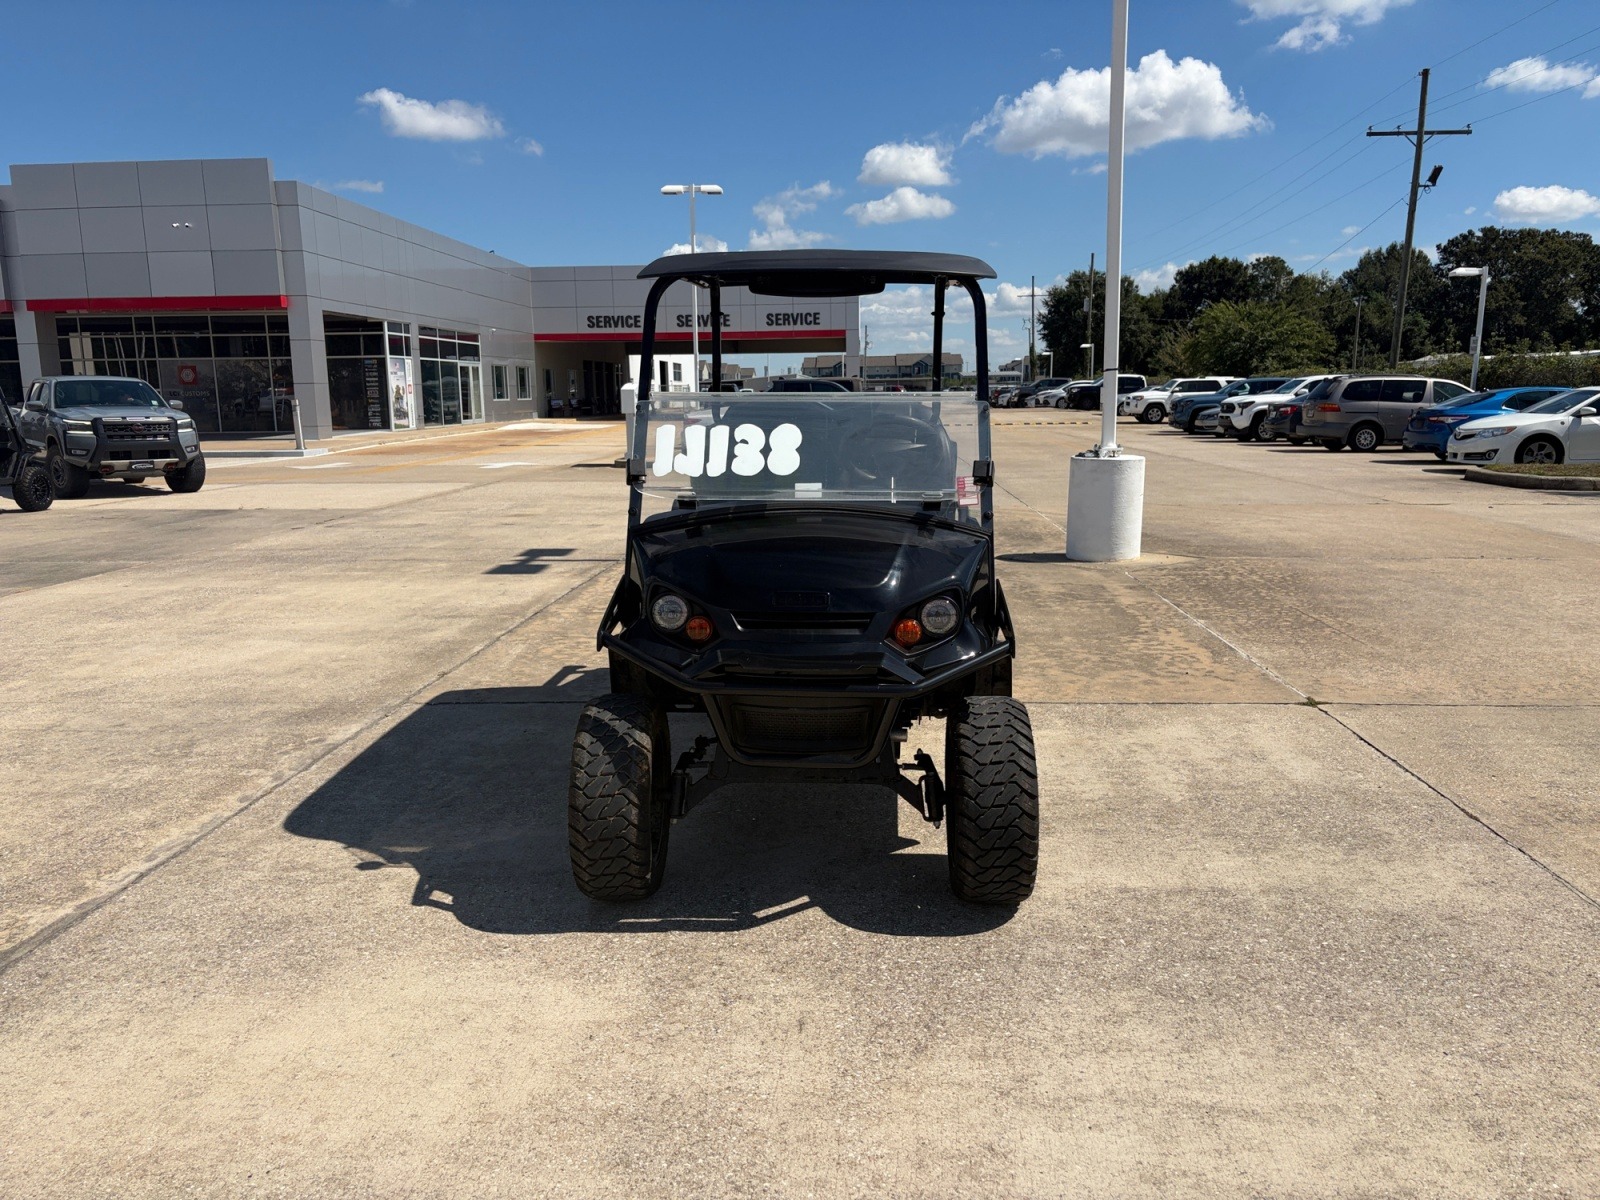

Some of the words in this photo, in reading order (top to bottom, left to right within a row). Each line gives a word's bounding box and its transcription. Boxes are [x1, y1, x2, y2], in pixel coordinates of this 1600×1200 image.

[587, 315, 641, 328] SERVICE
[676, 314, 731, 327] SEVE
[766, 312, 820, 326] SERVICE
